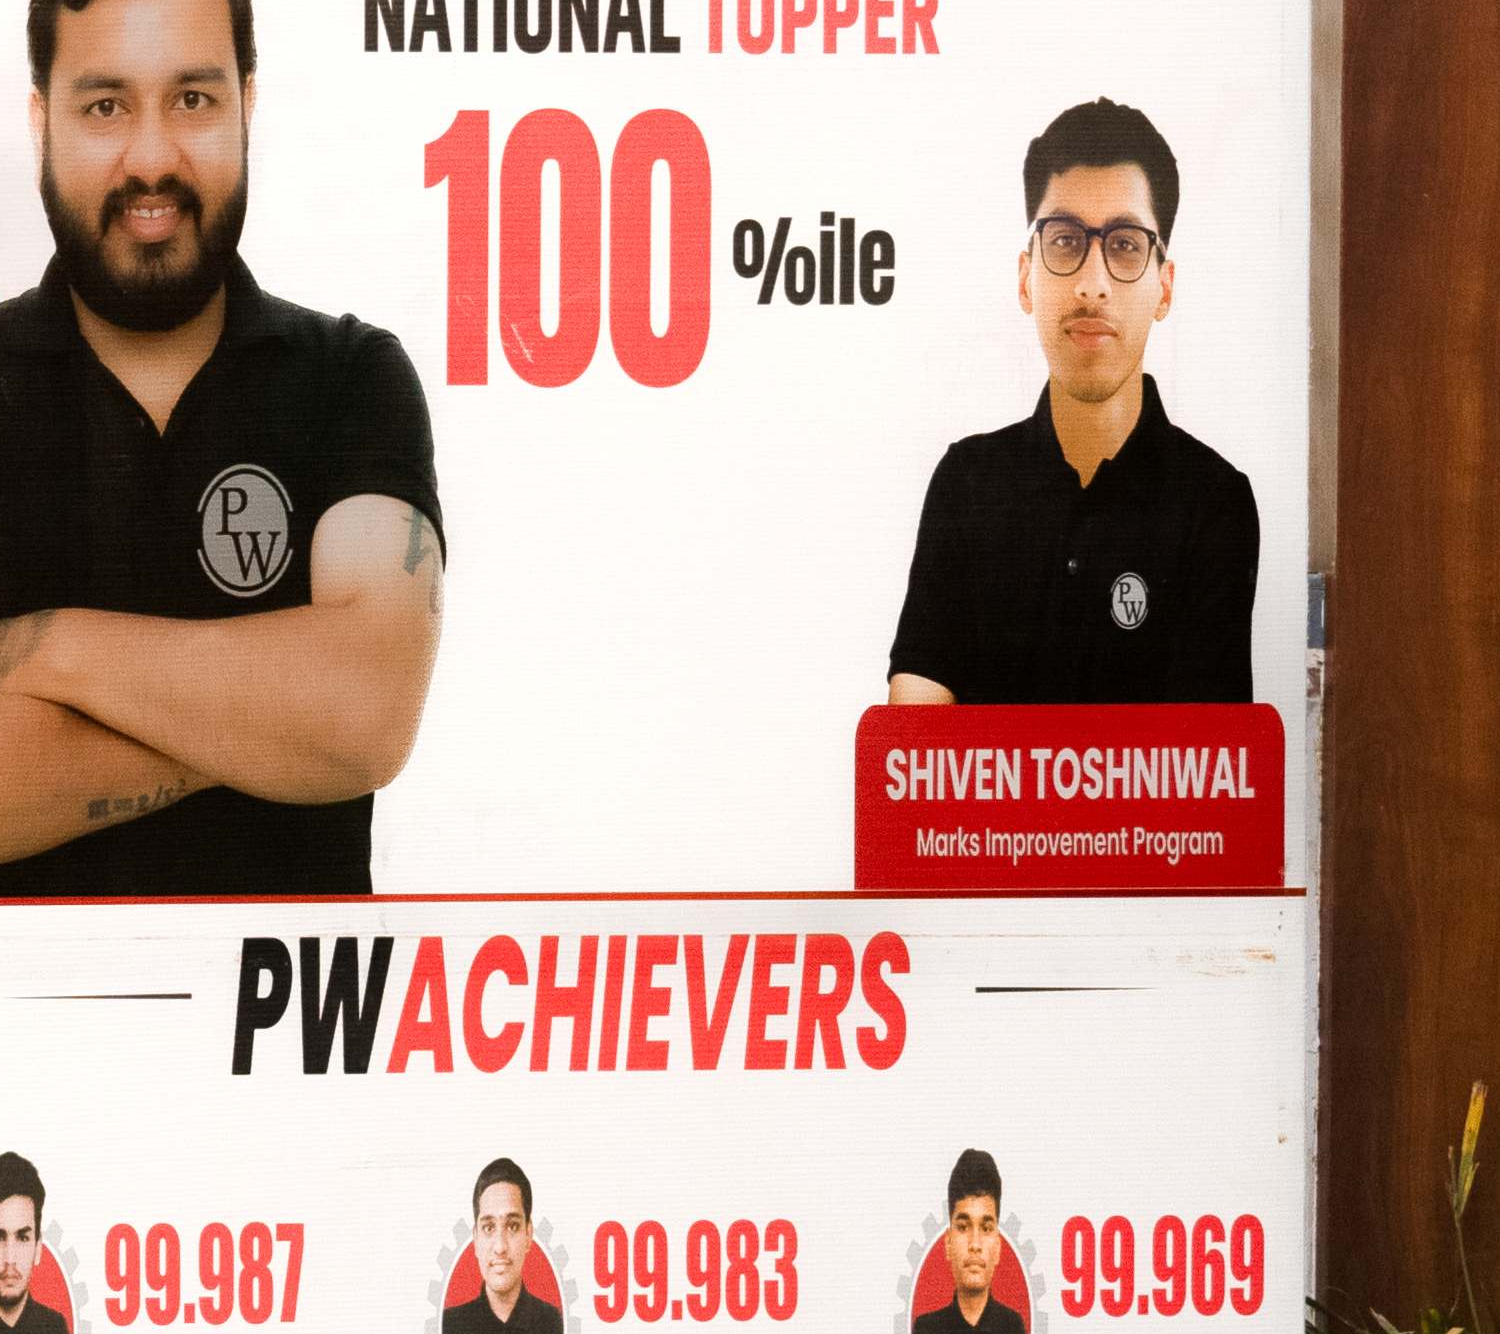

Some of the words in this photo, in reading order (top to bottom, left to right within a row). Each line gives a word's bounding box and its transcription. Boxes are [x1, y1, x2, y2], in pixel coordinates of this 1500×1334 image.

[423, 107, 712, 389] 100
[732, 210, 896, 307] %ile
[885, 748, 1022, 801] SHIVEN
[1030, 746, 1256, 800] TOSHNIWAL
[916, 825, 981, 857] Marks
[986, 826, 1128, 867] Improvement
[1132, 826, 1224, 866] Program
[104, 1221, 305, 1327] 99.987
[593, 1218, 799, 1324] 99.983
[1060, 1213, 1265, 1318] 99.969
